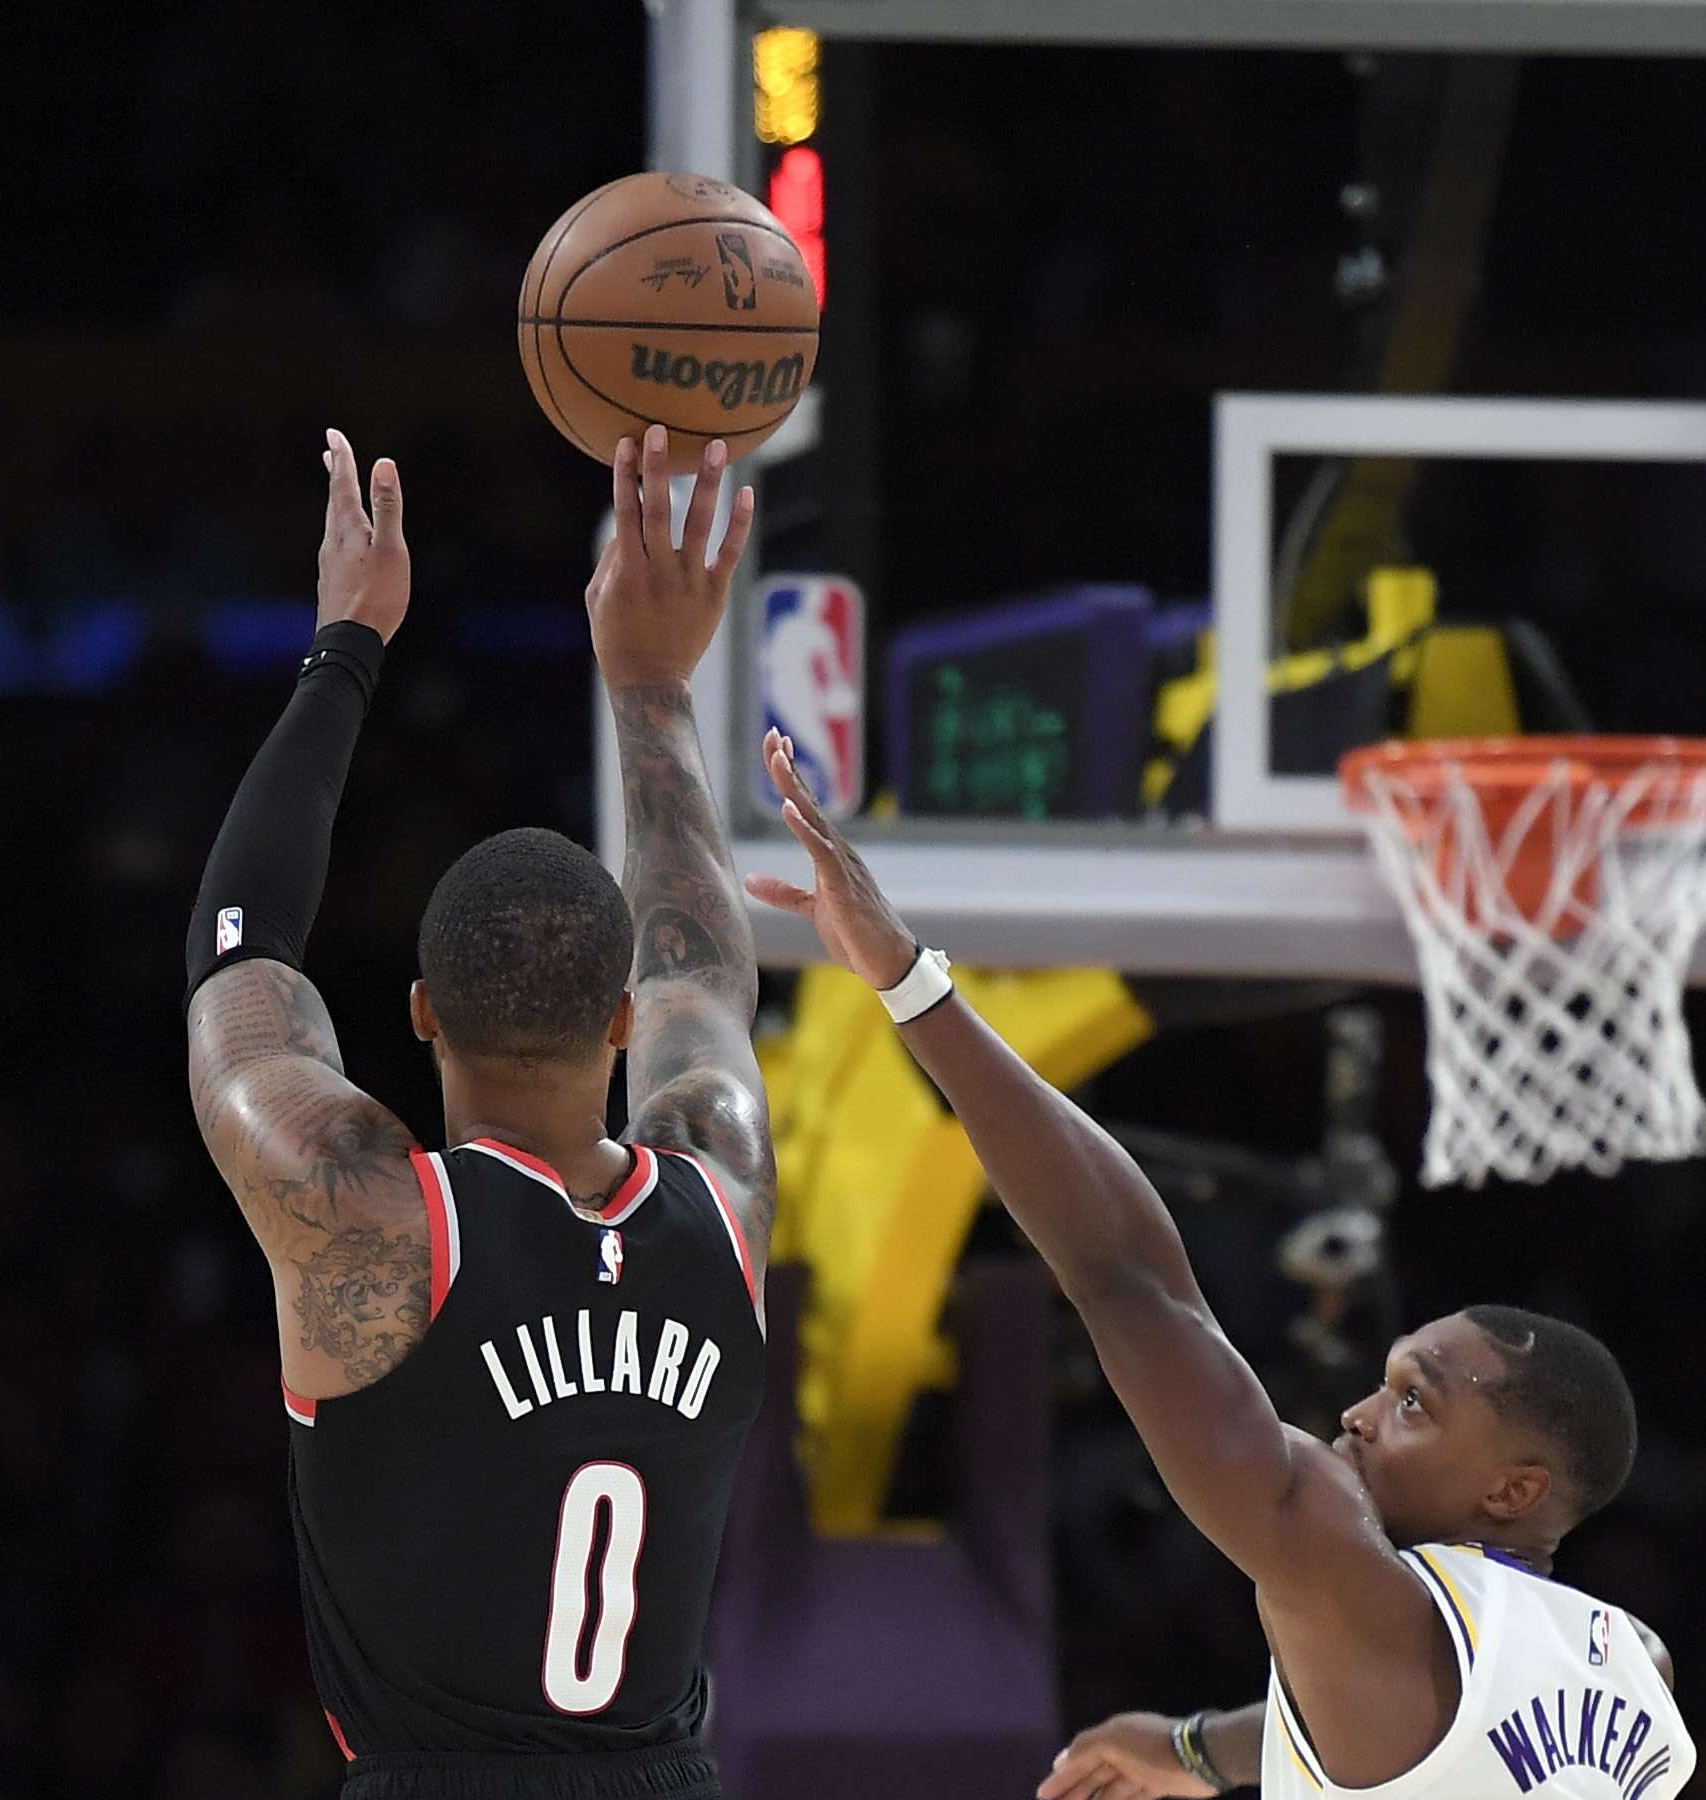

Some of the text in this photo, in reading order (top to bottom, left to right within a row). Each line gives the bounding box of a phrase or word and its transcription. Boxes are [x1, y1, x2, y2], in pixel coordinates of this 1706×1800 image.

[631, 343, 805, 410] Wilson
[480, 1308, 721, 1420] LILLARD
[542, 1460, 648, 1716] 0
[1488, 1687, 1652, 1794] WALKER
